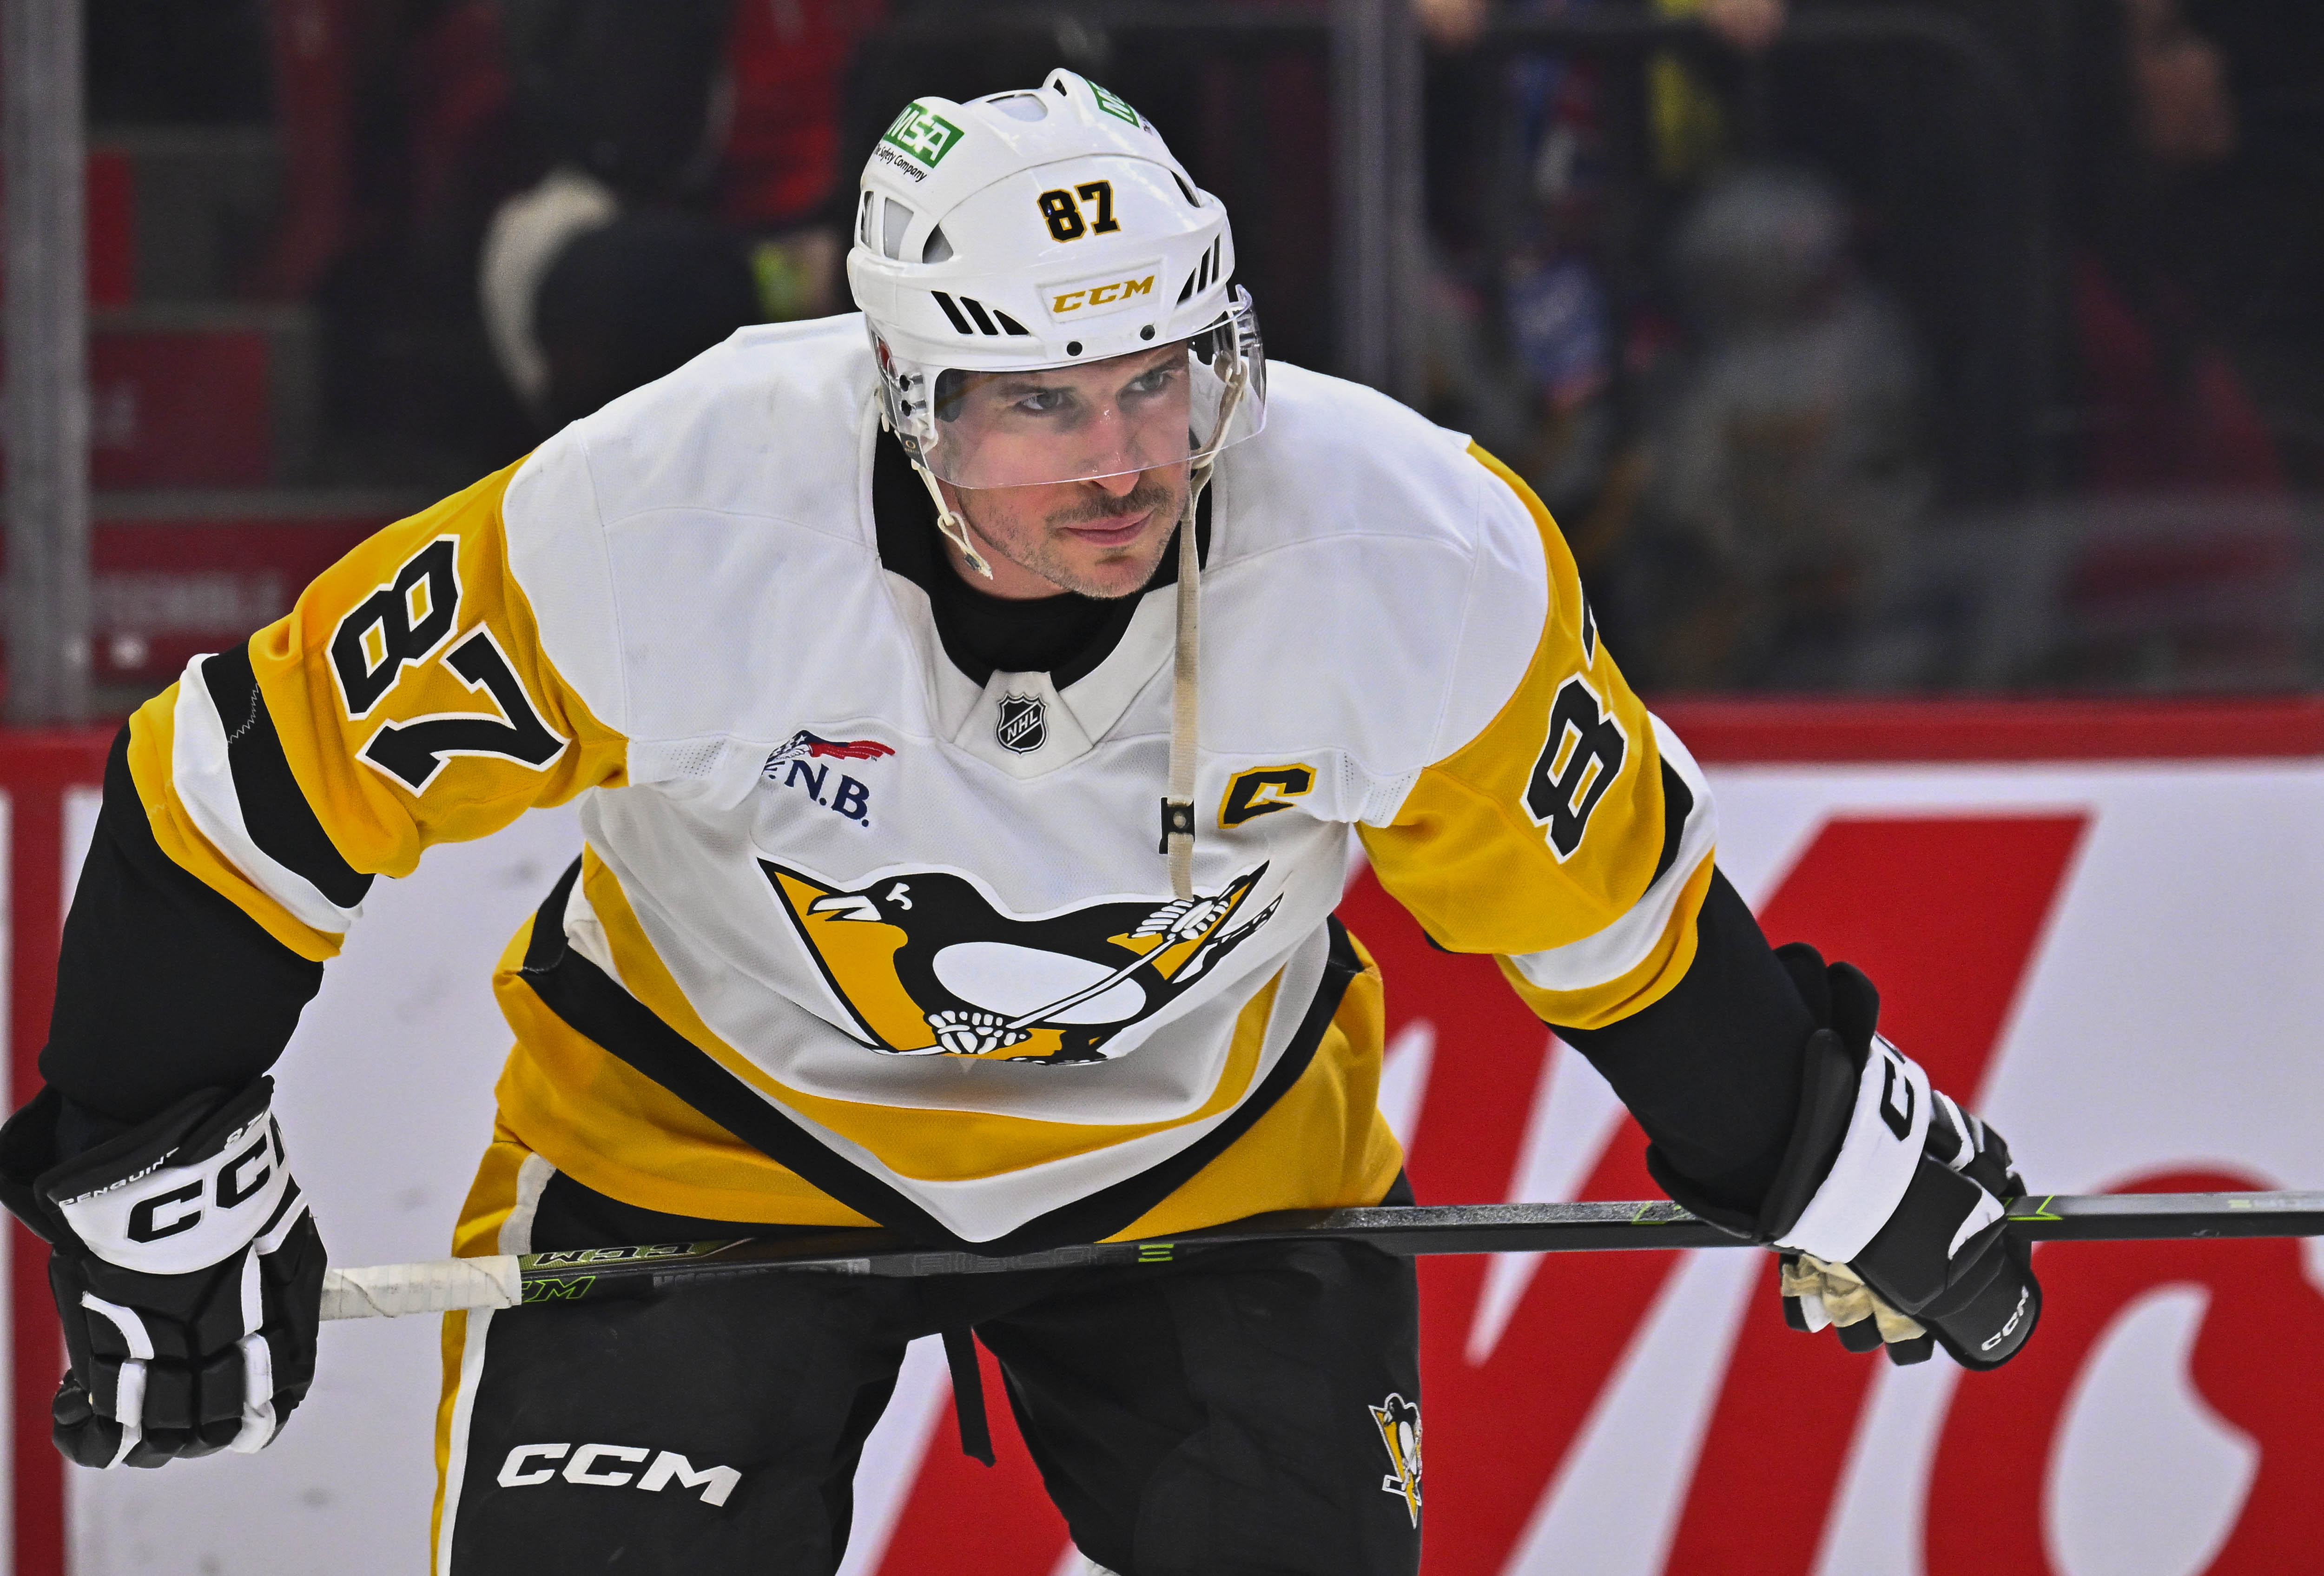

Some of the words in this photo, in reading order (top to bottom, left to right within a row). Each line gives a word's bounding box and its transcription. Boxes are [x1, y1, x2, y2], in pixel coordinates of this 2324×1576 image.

[887, 107, 951, 161] MSA
[893, 155, 927, 183] Company
[1037, 179, 1121, 243] 87
[1052, 275, 1155, 313] CCM
[326, 534, 571, 798] 87
[1007, 710, 1038, 742] NHL
[1519, 576, 1628, 864] 8
[1217, 762, 1317, 829] C
[1875, 1034, 1915, 1142] C
[534, 1242, 694, 1266] CCM
[496, 1443, 742, 1507] CCM
